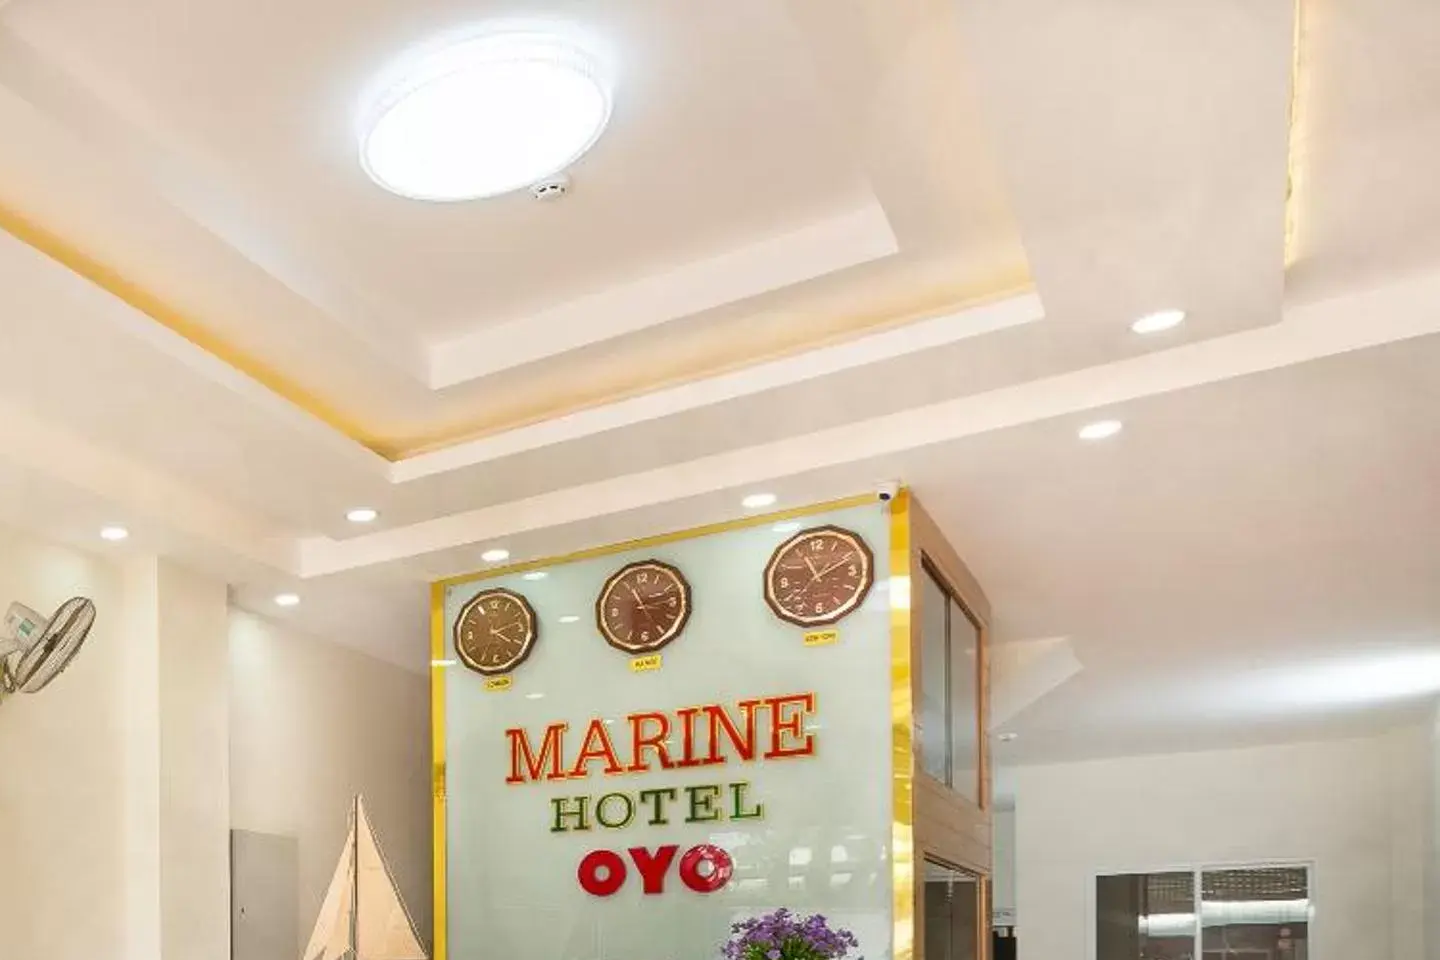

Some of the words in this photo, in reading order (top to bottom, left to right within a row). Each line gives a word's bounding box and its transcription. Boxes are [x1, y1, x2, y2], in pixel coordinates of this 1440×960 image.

[810, 539, 824, 551] 12
[504, 692, 816, 785] MARINE
[550, 781, 764, 833] HOTEL
[577, 843, 734, 897] OYO
